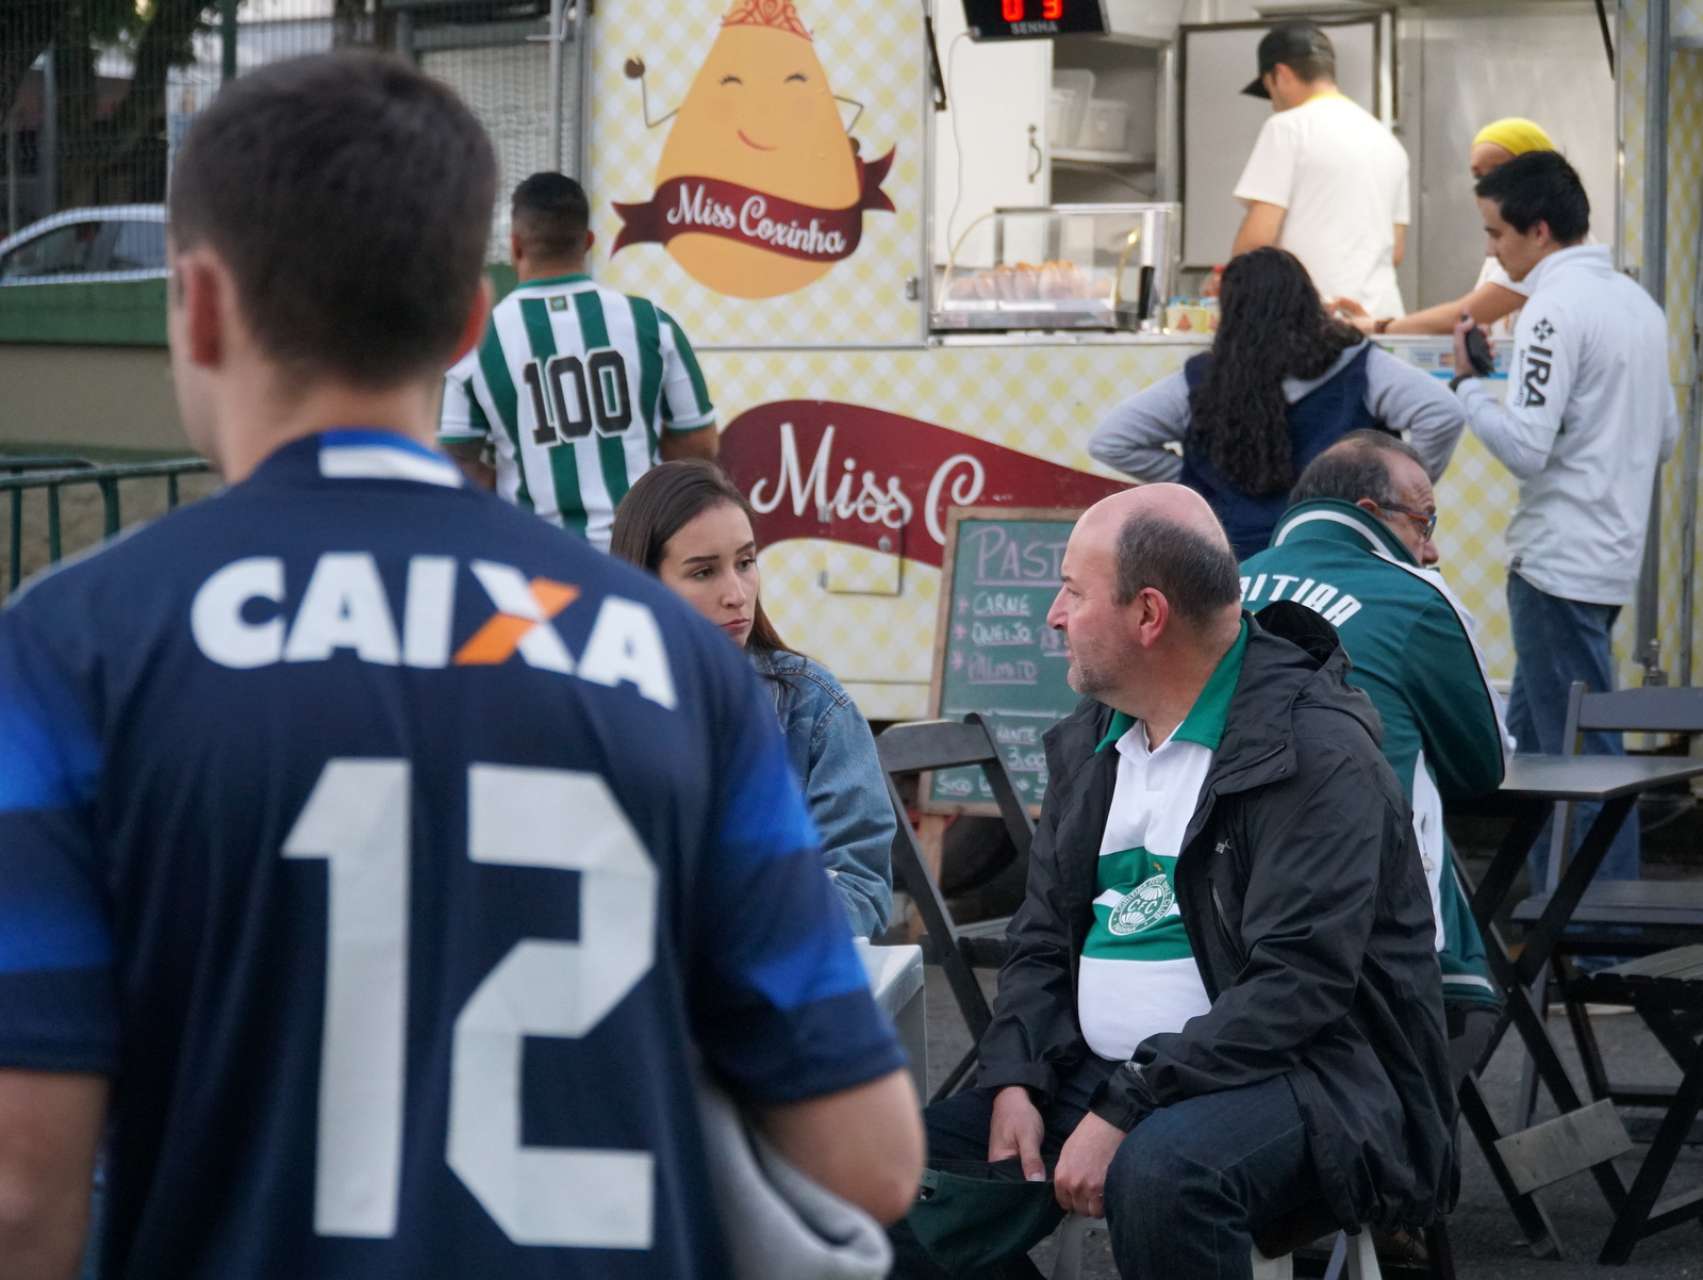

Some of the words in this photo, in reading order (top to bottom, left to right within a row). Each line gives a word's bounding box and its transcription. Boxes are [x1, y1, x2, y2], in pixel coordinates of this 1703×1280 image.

[666, 182, 737, 230] Miss
[739, 195, 846, 255] Coxinha
[523, 351, 633, 445] 100
[1524, 344, 1553, 408] IRA
[750, 422, 913, 530] Miss
[966, 525, 1064, 580] PAST
[191, 552, 677, 710] CAIXA
[1127, 898, 1158, 915] CFC
[280, 756, 659, 1250] 12
